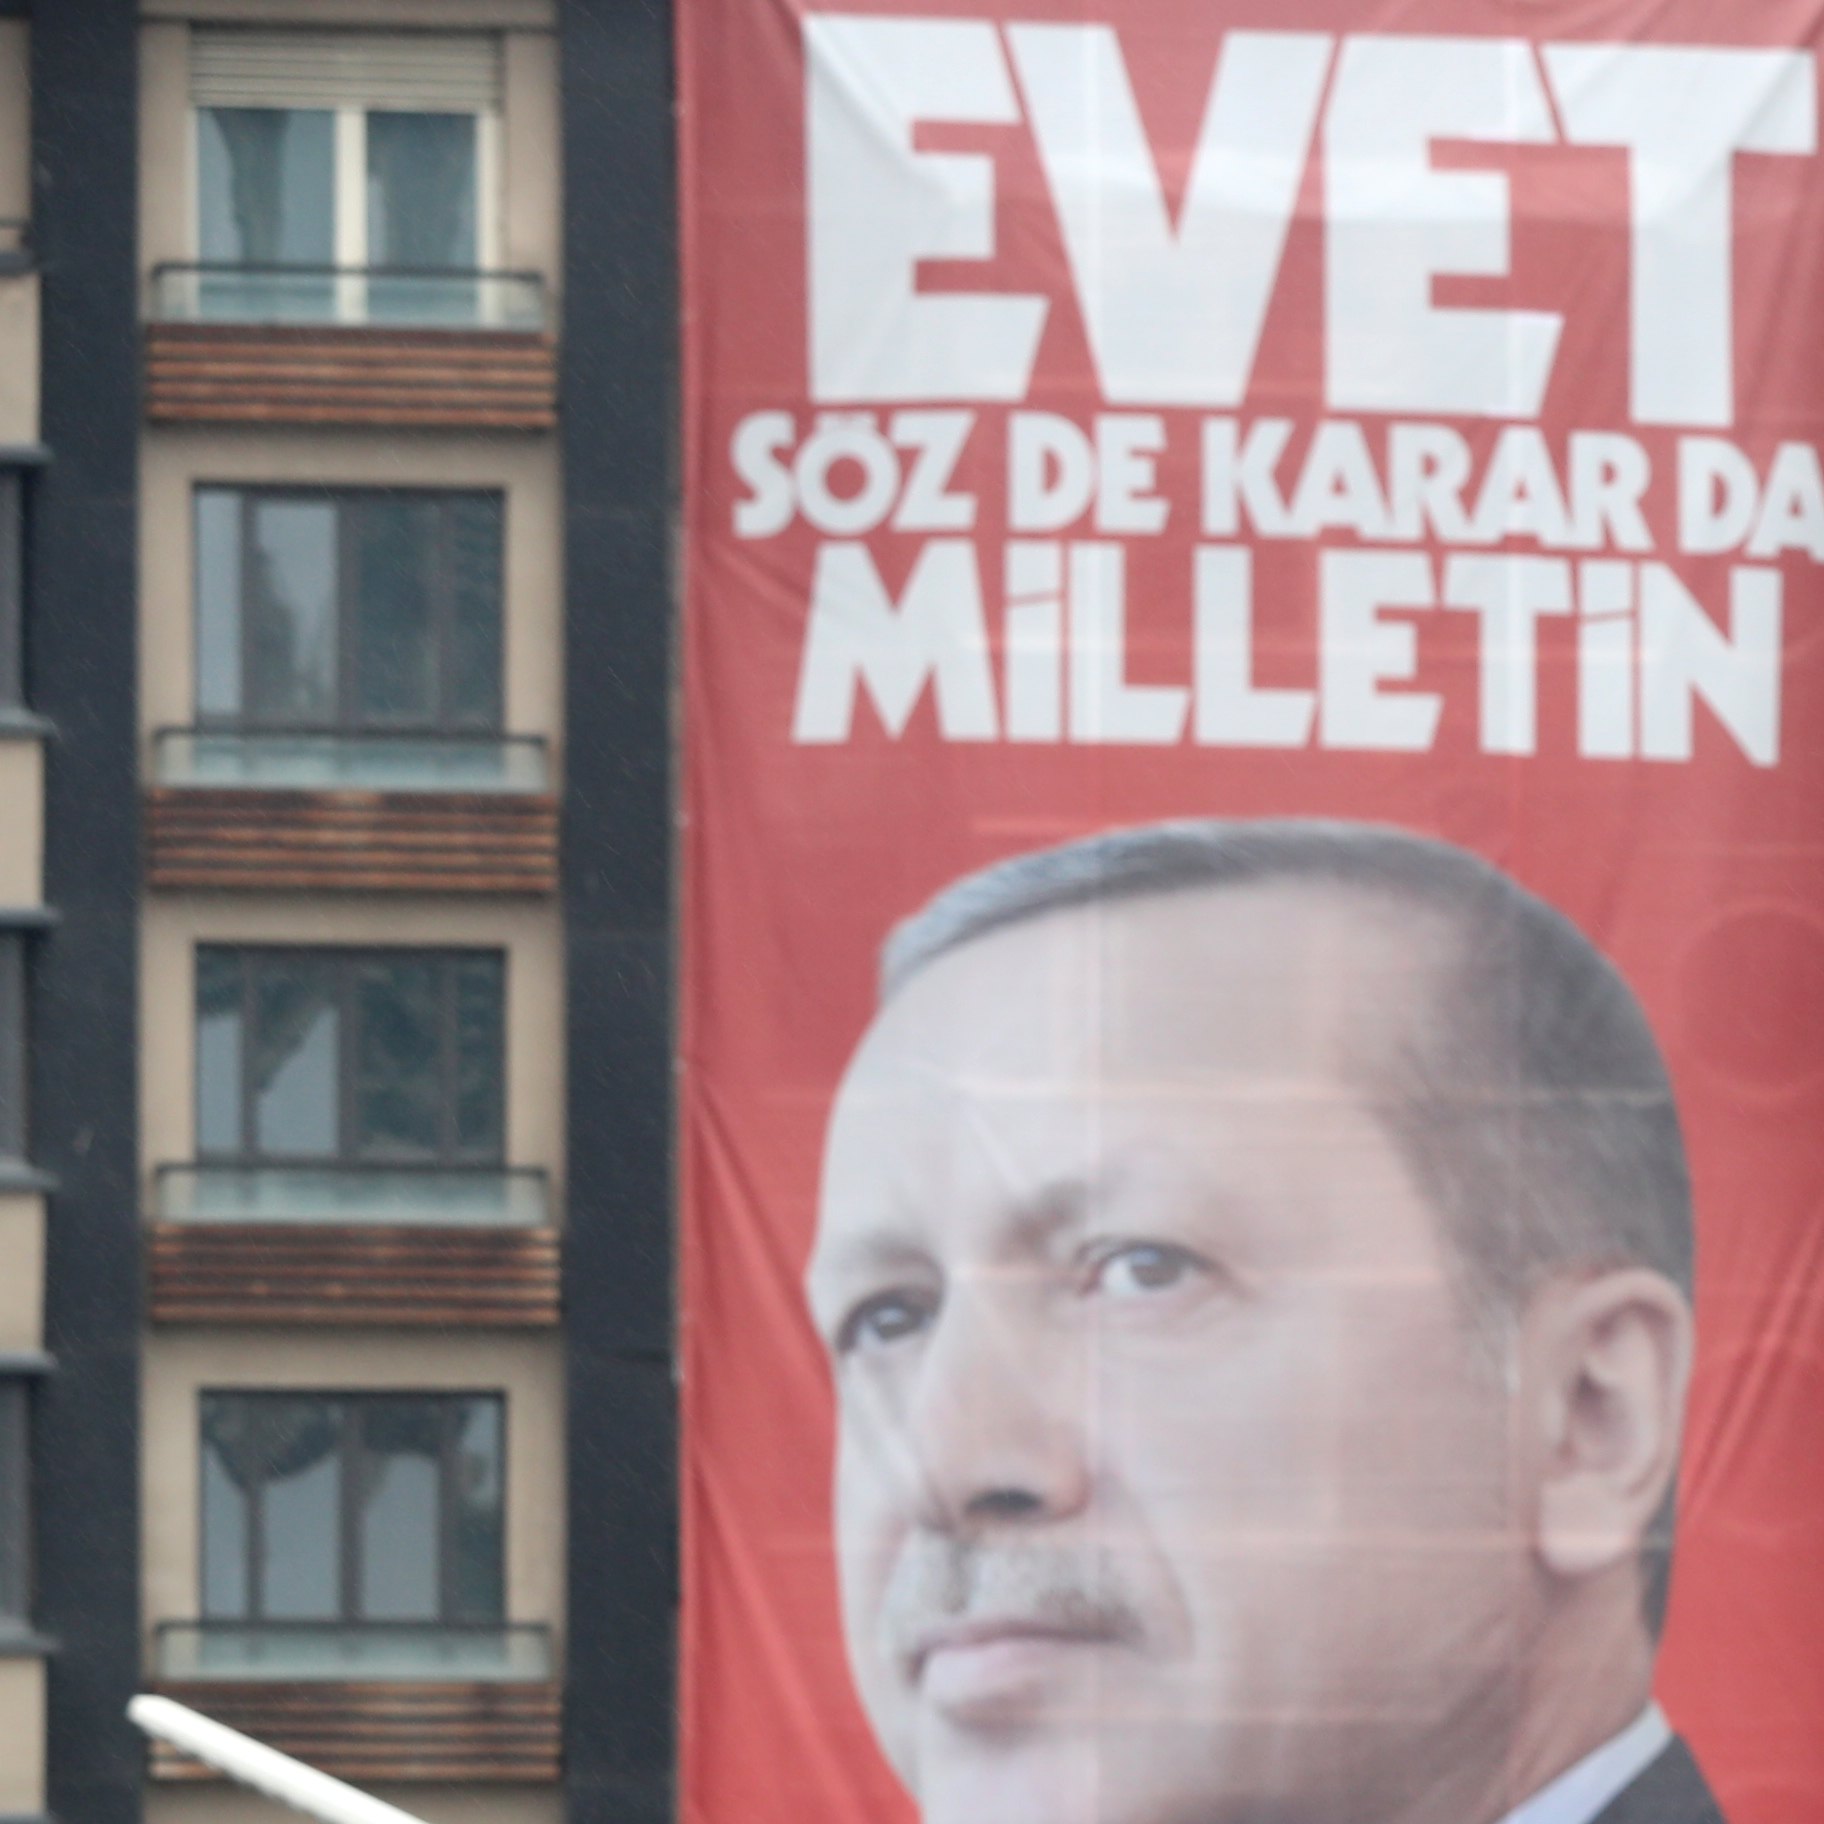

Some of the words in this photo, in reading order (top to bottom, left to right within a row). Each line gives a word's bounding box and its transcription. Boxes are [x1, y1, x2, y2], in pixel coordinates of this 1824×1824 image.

[804, 12, 1817, 428] EVET
[730, 408, 979, 539] SÖZ
[1005, 411, 1171, 536] DE
[1201, 417, 1655, 553] KARAR
[790, 539, 1783, 769] MİLLETİN
